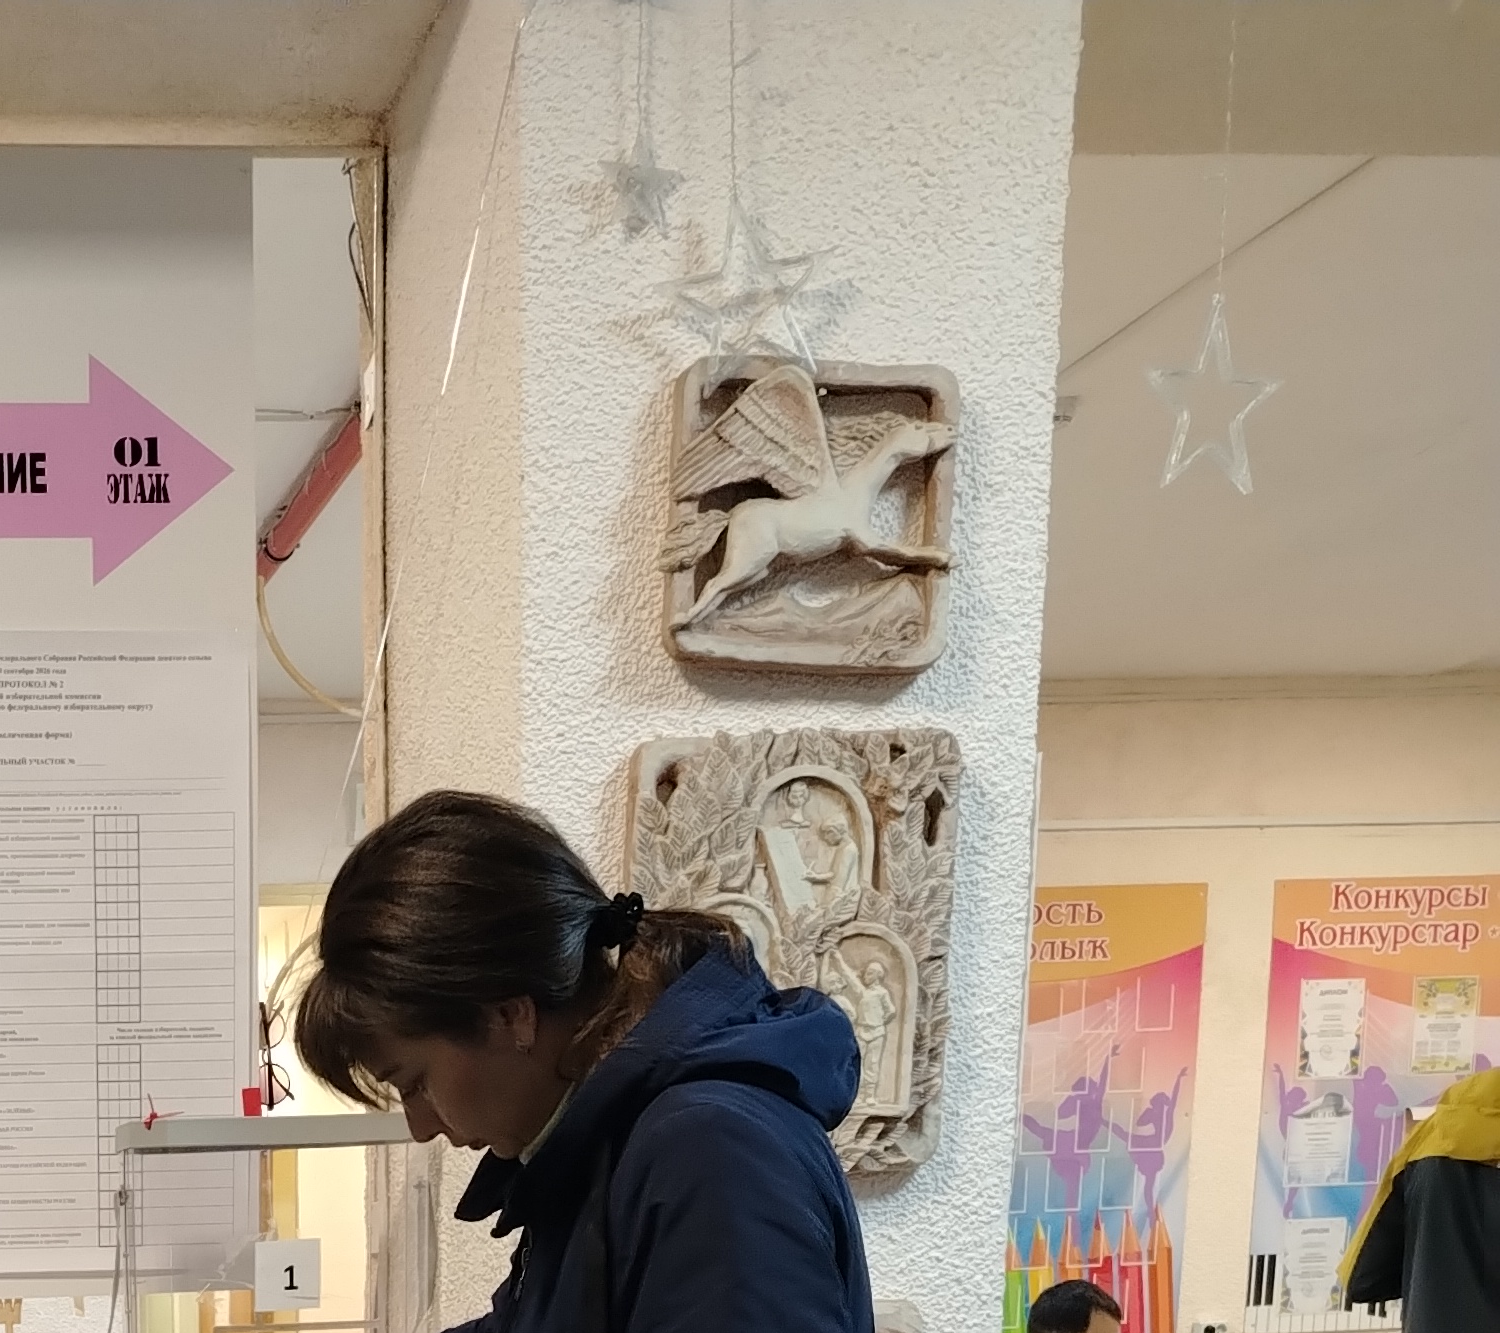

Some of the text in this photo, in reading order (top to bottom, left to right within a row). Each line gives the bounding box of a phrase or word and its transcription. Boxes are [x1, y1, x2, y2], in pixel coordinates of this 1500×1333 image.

[113, 437, 162, 467] 01
[106, 473, 171, 504] ЭТАЖ
[29, 758, 67, 766] УЧАСТОК
[1333, 883, 1487, 916] Конкурсы
[1298, 920, 1480, 952] Конкурстар
[284, 1265, 299, 1290] 1
